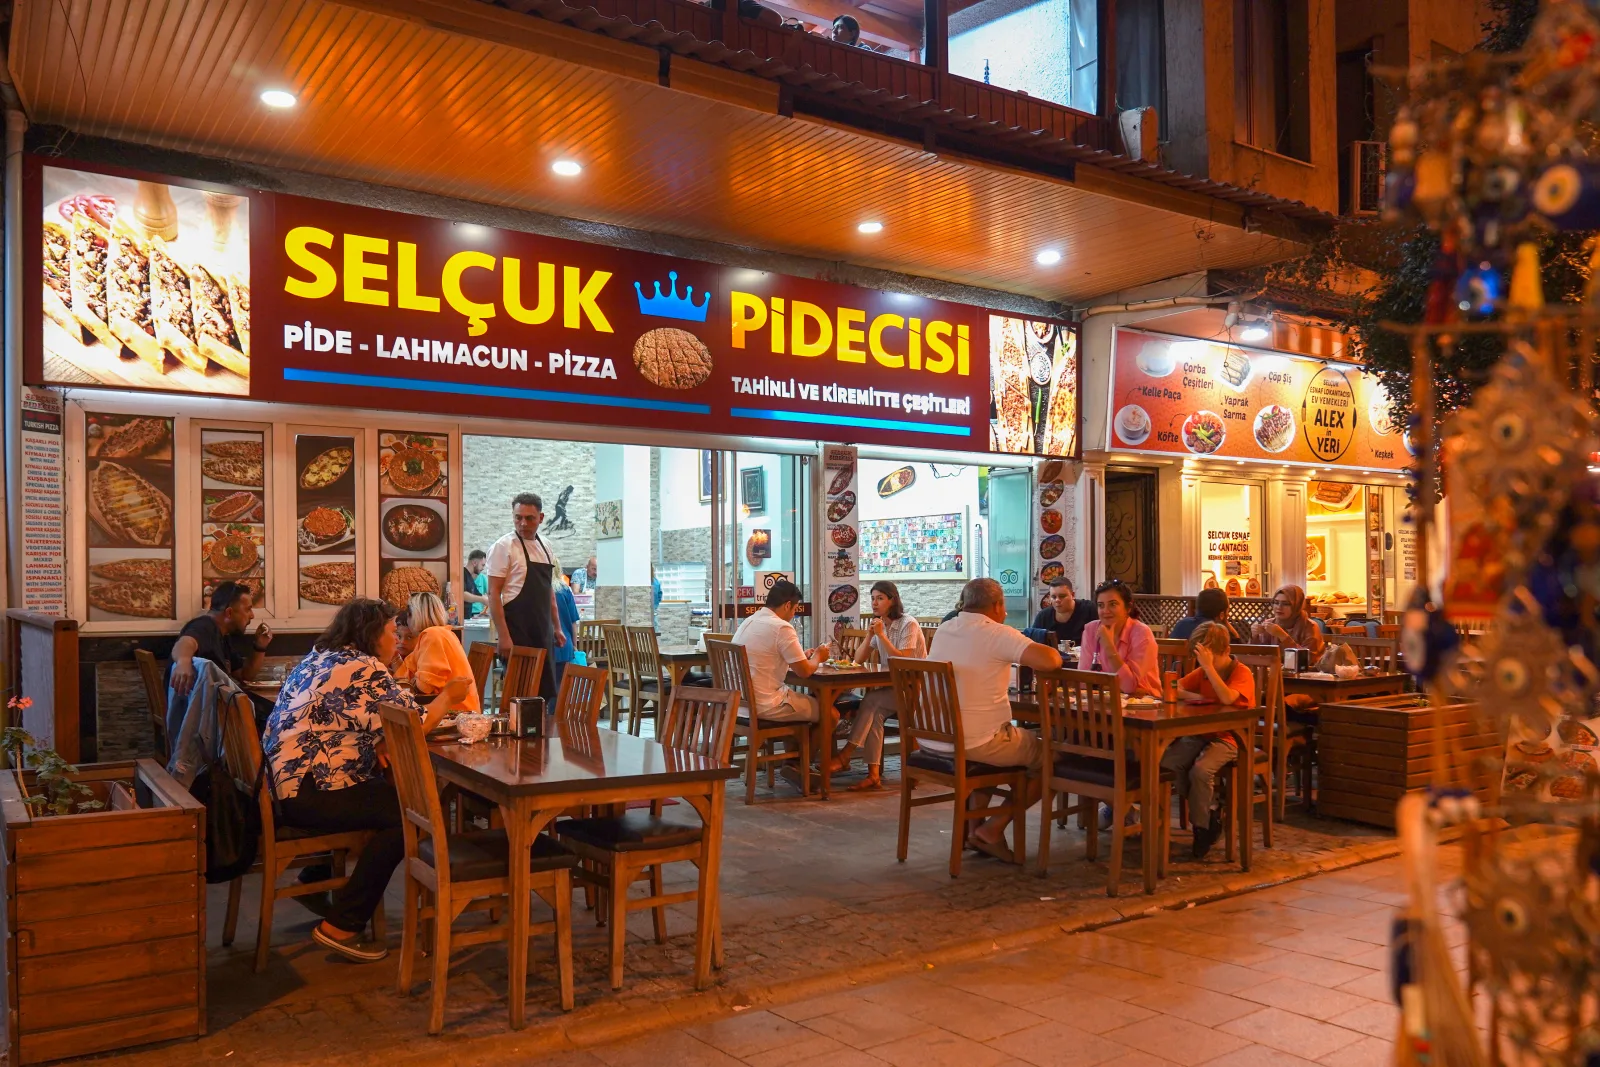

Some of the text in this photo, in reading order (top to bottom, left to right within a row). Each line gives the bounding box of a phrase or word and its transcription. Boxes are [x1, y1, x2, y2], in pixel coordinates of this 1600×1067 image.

[284, 226, 614, 336] SELÇUK
[731, 291, 970, 376] PİDECİSİ
[284, 321, 352, 354] PİDE
[376, 334, 528, 372] LAHMACUN
[549, 349, 617, 380] PİZZA
[1183, 362, 1207, 375] Çorba
[1182, 376, 1214, 390] Çeşitleri
[1268, 371, 1282, 384] Çöp
[731, 376, 970, 416] TAHİNLİ VE KİREMİTTE ÇEŞİTLERİ
[1142, 385, 1182, 401] Kelle Paça
[1309, 386, 1323, 395] ESNAF
[1223, 396, 1249, 408] Yaprak
[1311, 395, 1319, 404] EV
[1223, 407, 1247, 420] Sarma
[1314, 408, 1345, 429] ALEX
[1157, 430, 1179, 442] Köfte
[1326, 429, 1332, 437] in
[1317, 436, 1341, 454] YERİ
[1374, 449, 1394, 459] Keşkek
